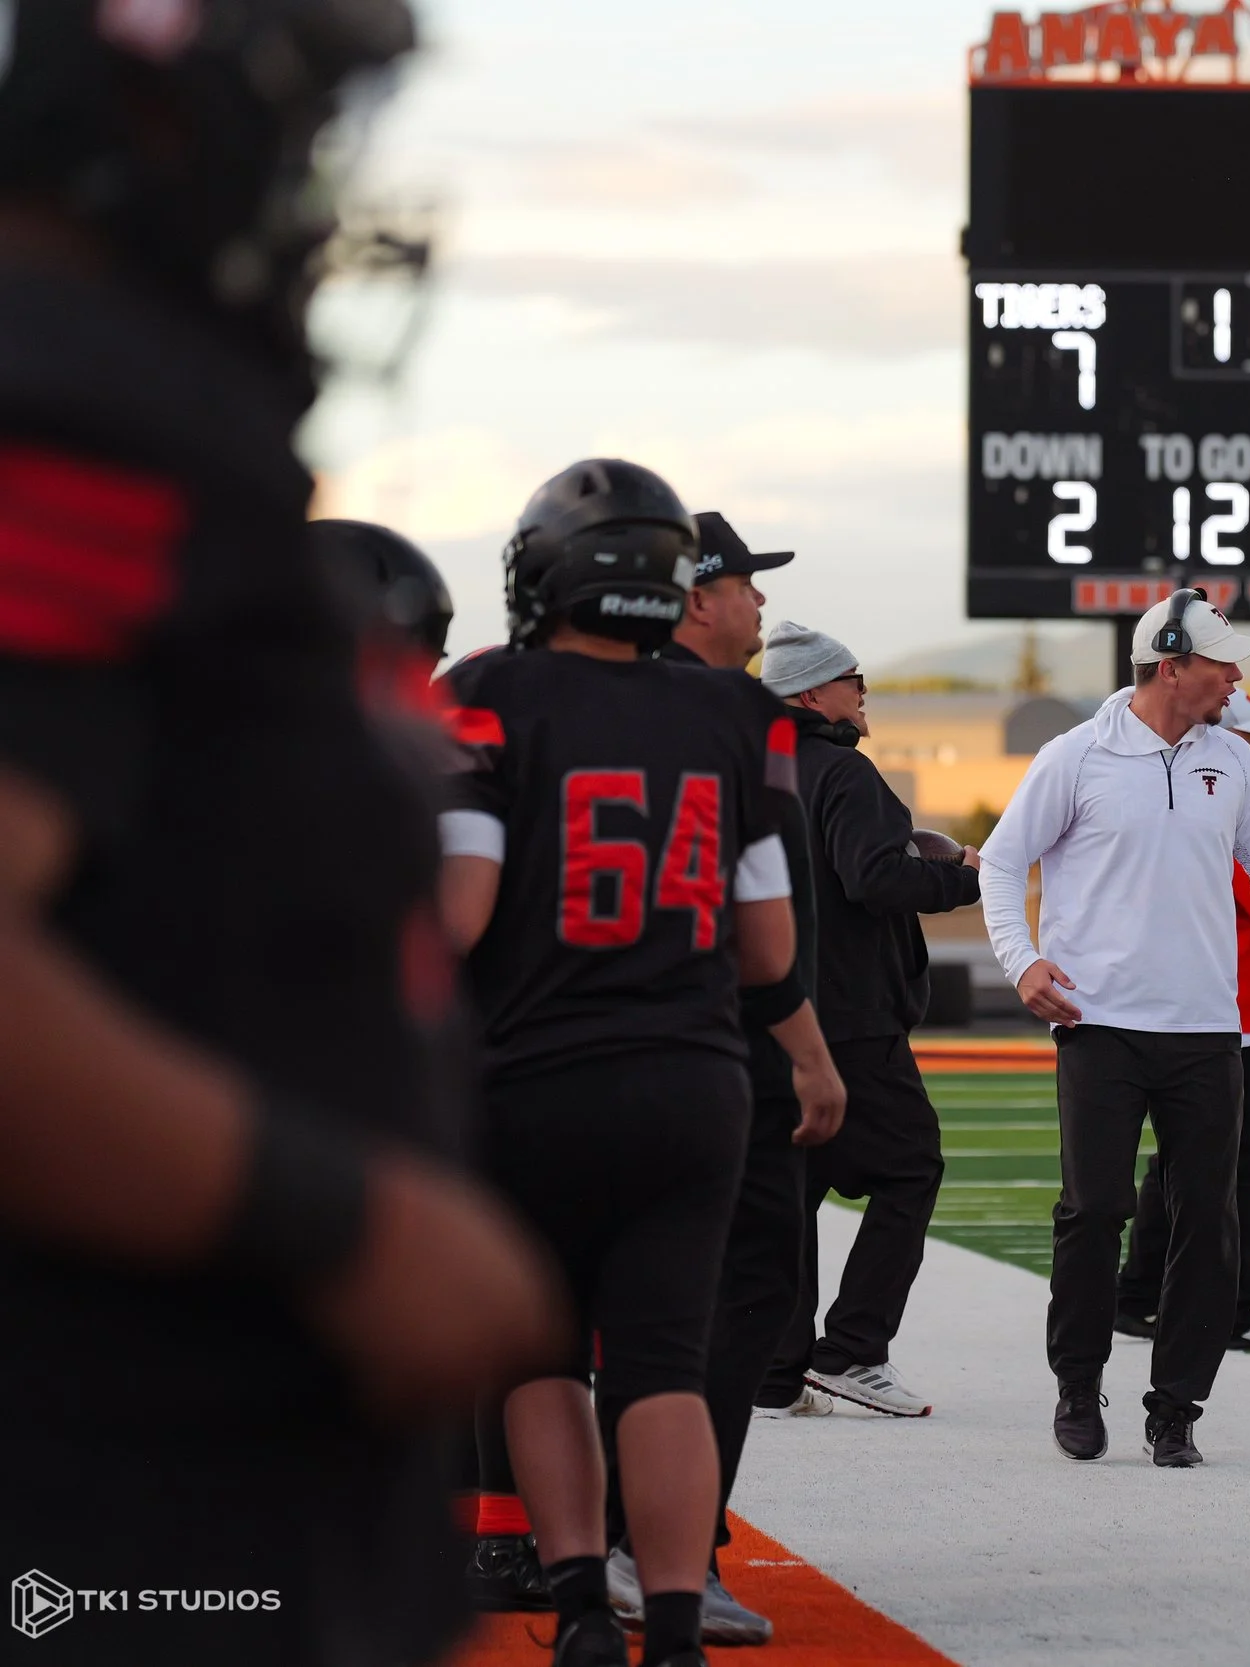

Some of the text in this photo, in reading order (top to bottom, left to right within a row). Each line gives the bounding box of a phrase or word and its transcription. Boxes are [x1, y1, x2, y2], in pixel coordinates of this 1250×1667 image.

[985, 11, 1237, 75] ANAYA
[1051, 331, 1096, 410] 7
[982, 432, 1103, 479] DOWN
[1138, 434, 1194, 481] TO
[1048, 481, 1097, 563] 2
[1173, 482, 1249, 565] 12
[558, 768, 725, 951] 64
